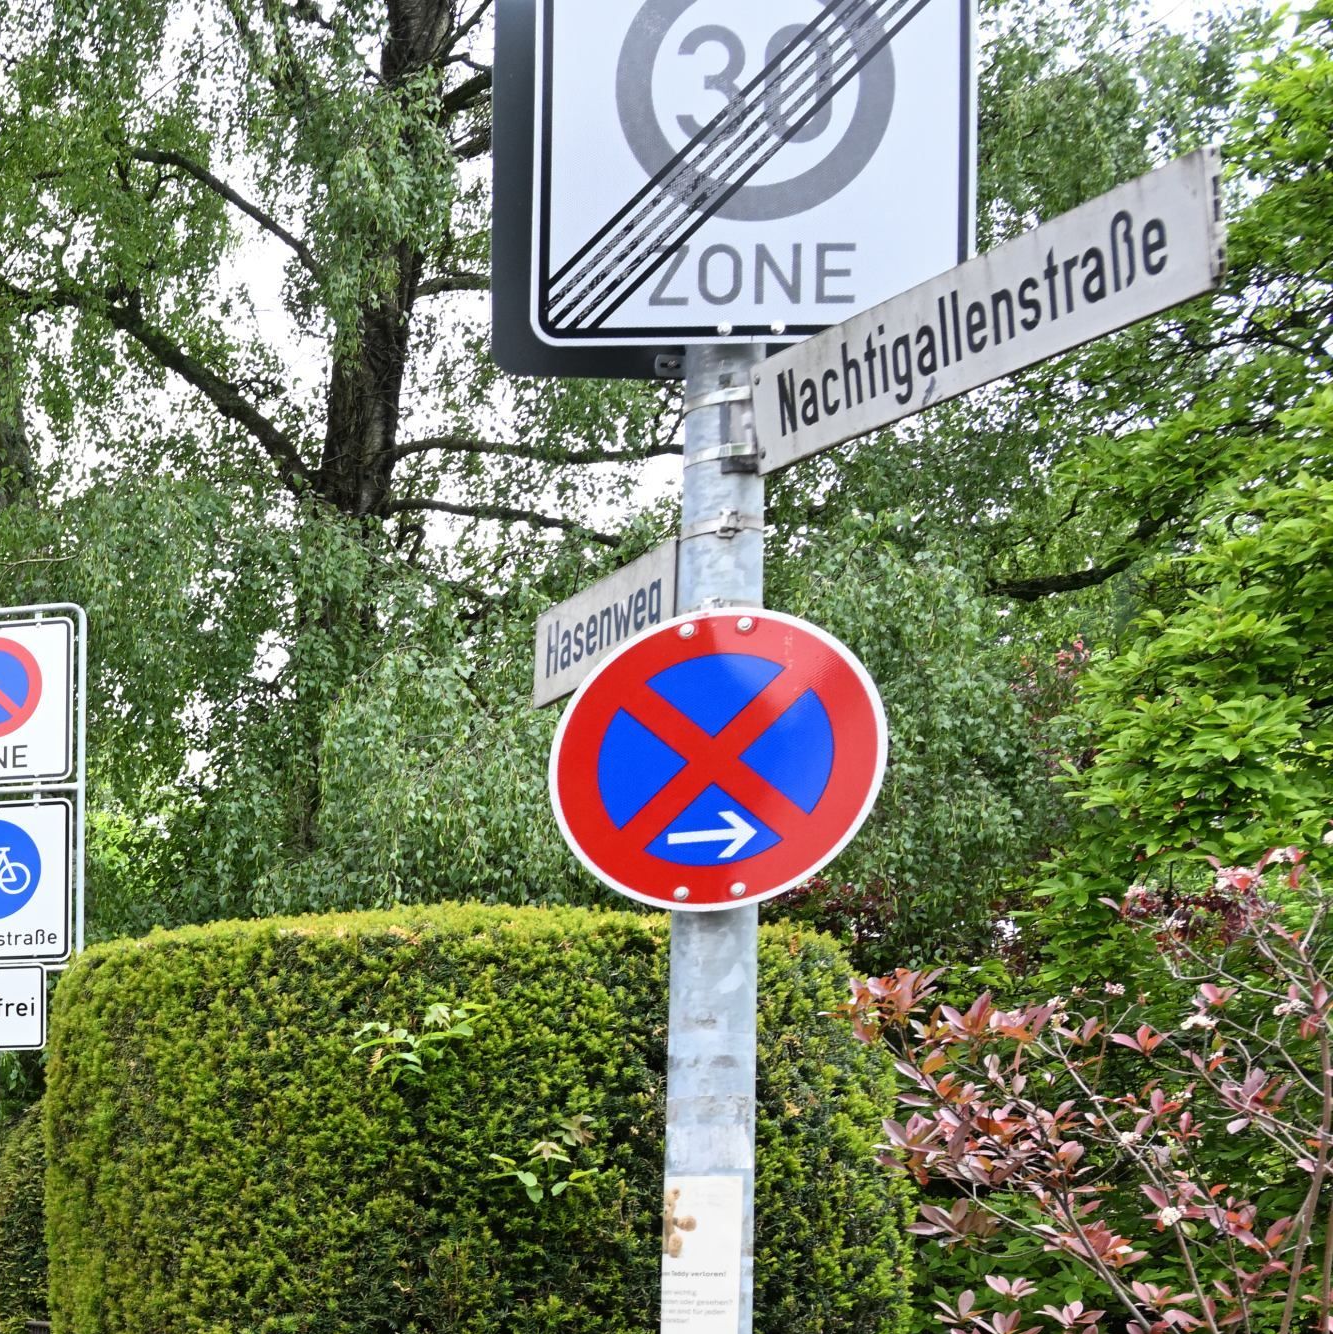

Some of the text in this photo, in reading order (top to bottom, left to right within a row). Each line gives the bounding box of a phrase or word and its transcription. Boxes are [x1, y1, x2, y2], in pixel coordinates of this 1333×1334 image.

[676, 23, 833, 144] 30
[648, 243, 856, 306] ZONE
[776, 209, 1169, 437] Nachtigallenstraße
